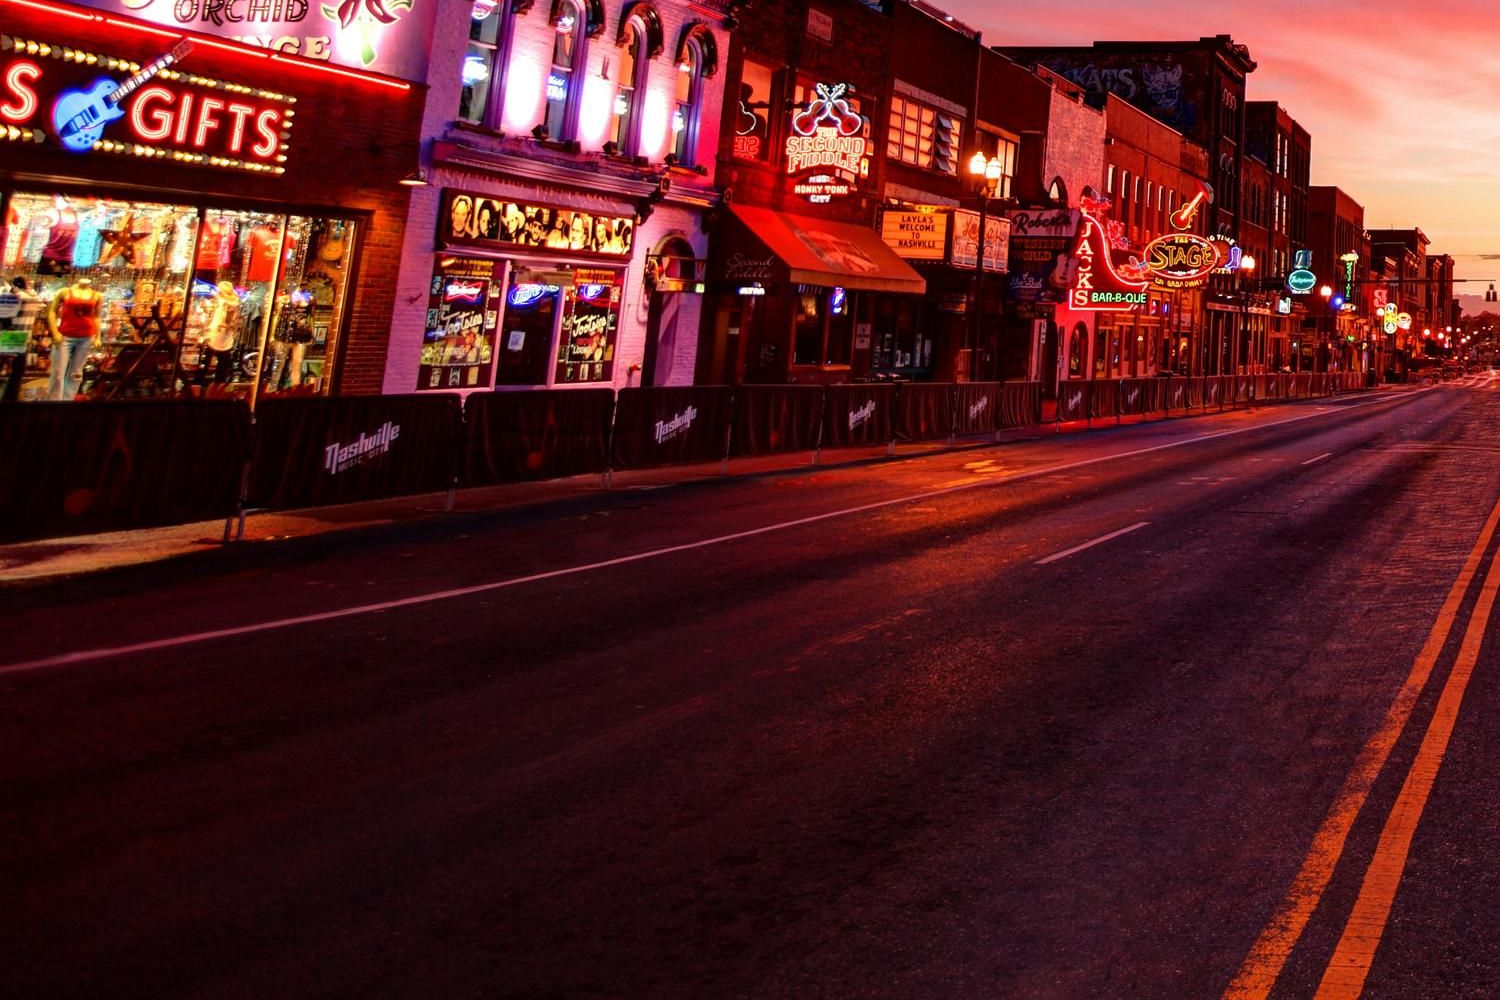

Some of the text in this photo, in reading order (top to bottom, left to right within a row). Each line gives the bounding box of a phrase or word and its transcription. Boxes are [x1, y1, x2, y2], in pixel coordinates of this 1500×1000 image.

[132, 87, 280, 158] GIFTS
[786, 136, 865, 156] SECOND
[788, 152, 860, 174] FIDDLE
[901, 215, 934, 224] LAYLA'S
[899, 224, 936, 233] WELCOME
[912, 232, 921, 240] TO
[898, 240, 936, 249] NASHVILLE
[1149, 240, 1215, 270] STAGE
[1092, 292, 1147, 303] BAR-B-QUE
[325, 421, 400, 475] Nashville
